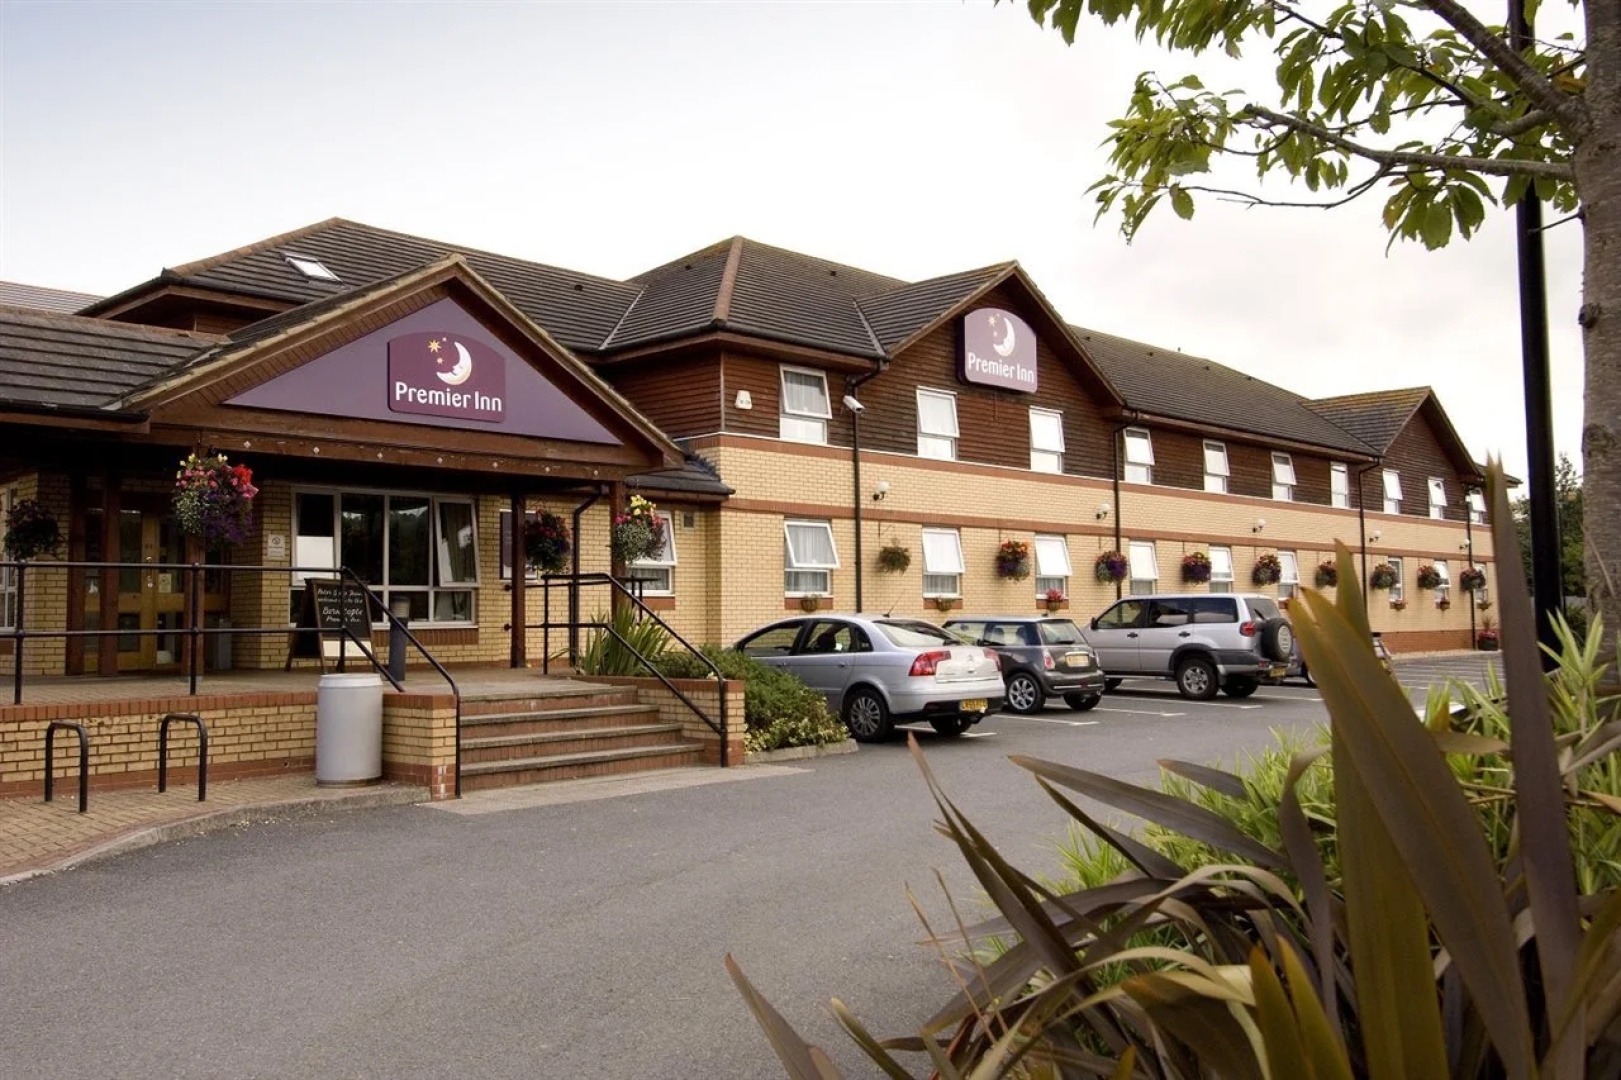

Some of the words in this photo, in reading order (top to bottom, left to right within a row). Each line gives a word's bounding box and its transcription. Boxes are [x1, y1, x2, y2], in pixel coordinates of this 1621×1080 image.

[968, 352, 1015, 378] Premier
[1017, 362, 1034, 383] Inn
[395, 381, 471, 408] Premier
[474, 391, 502, 412] Inn
